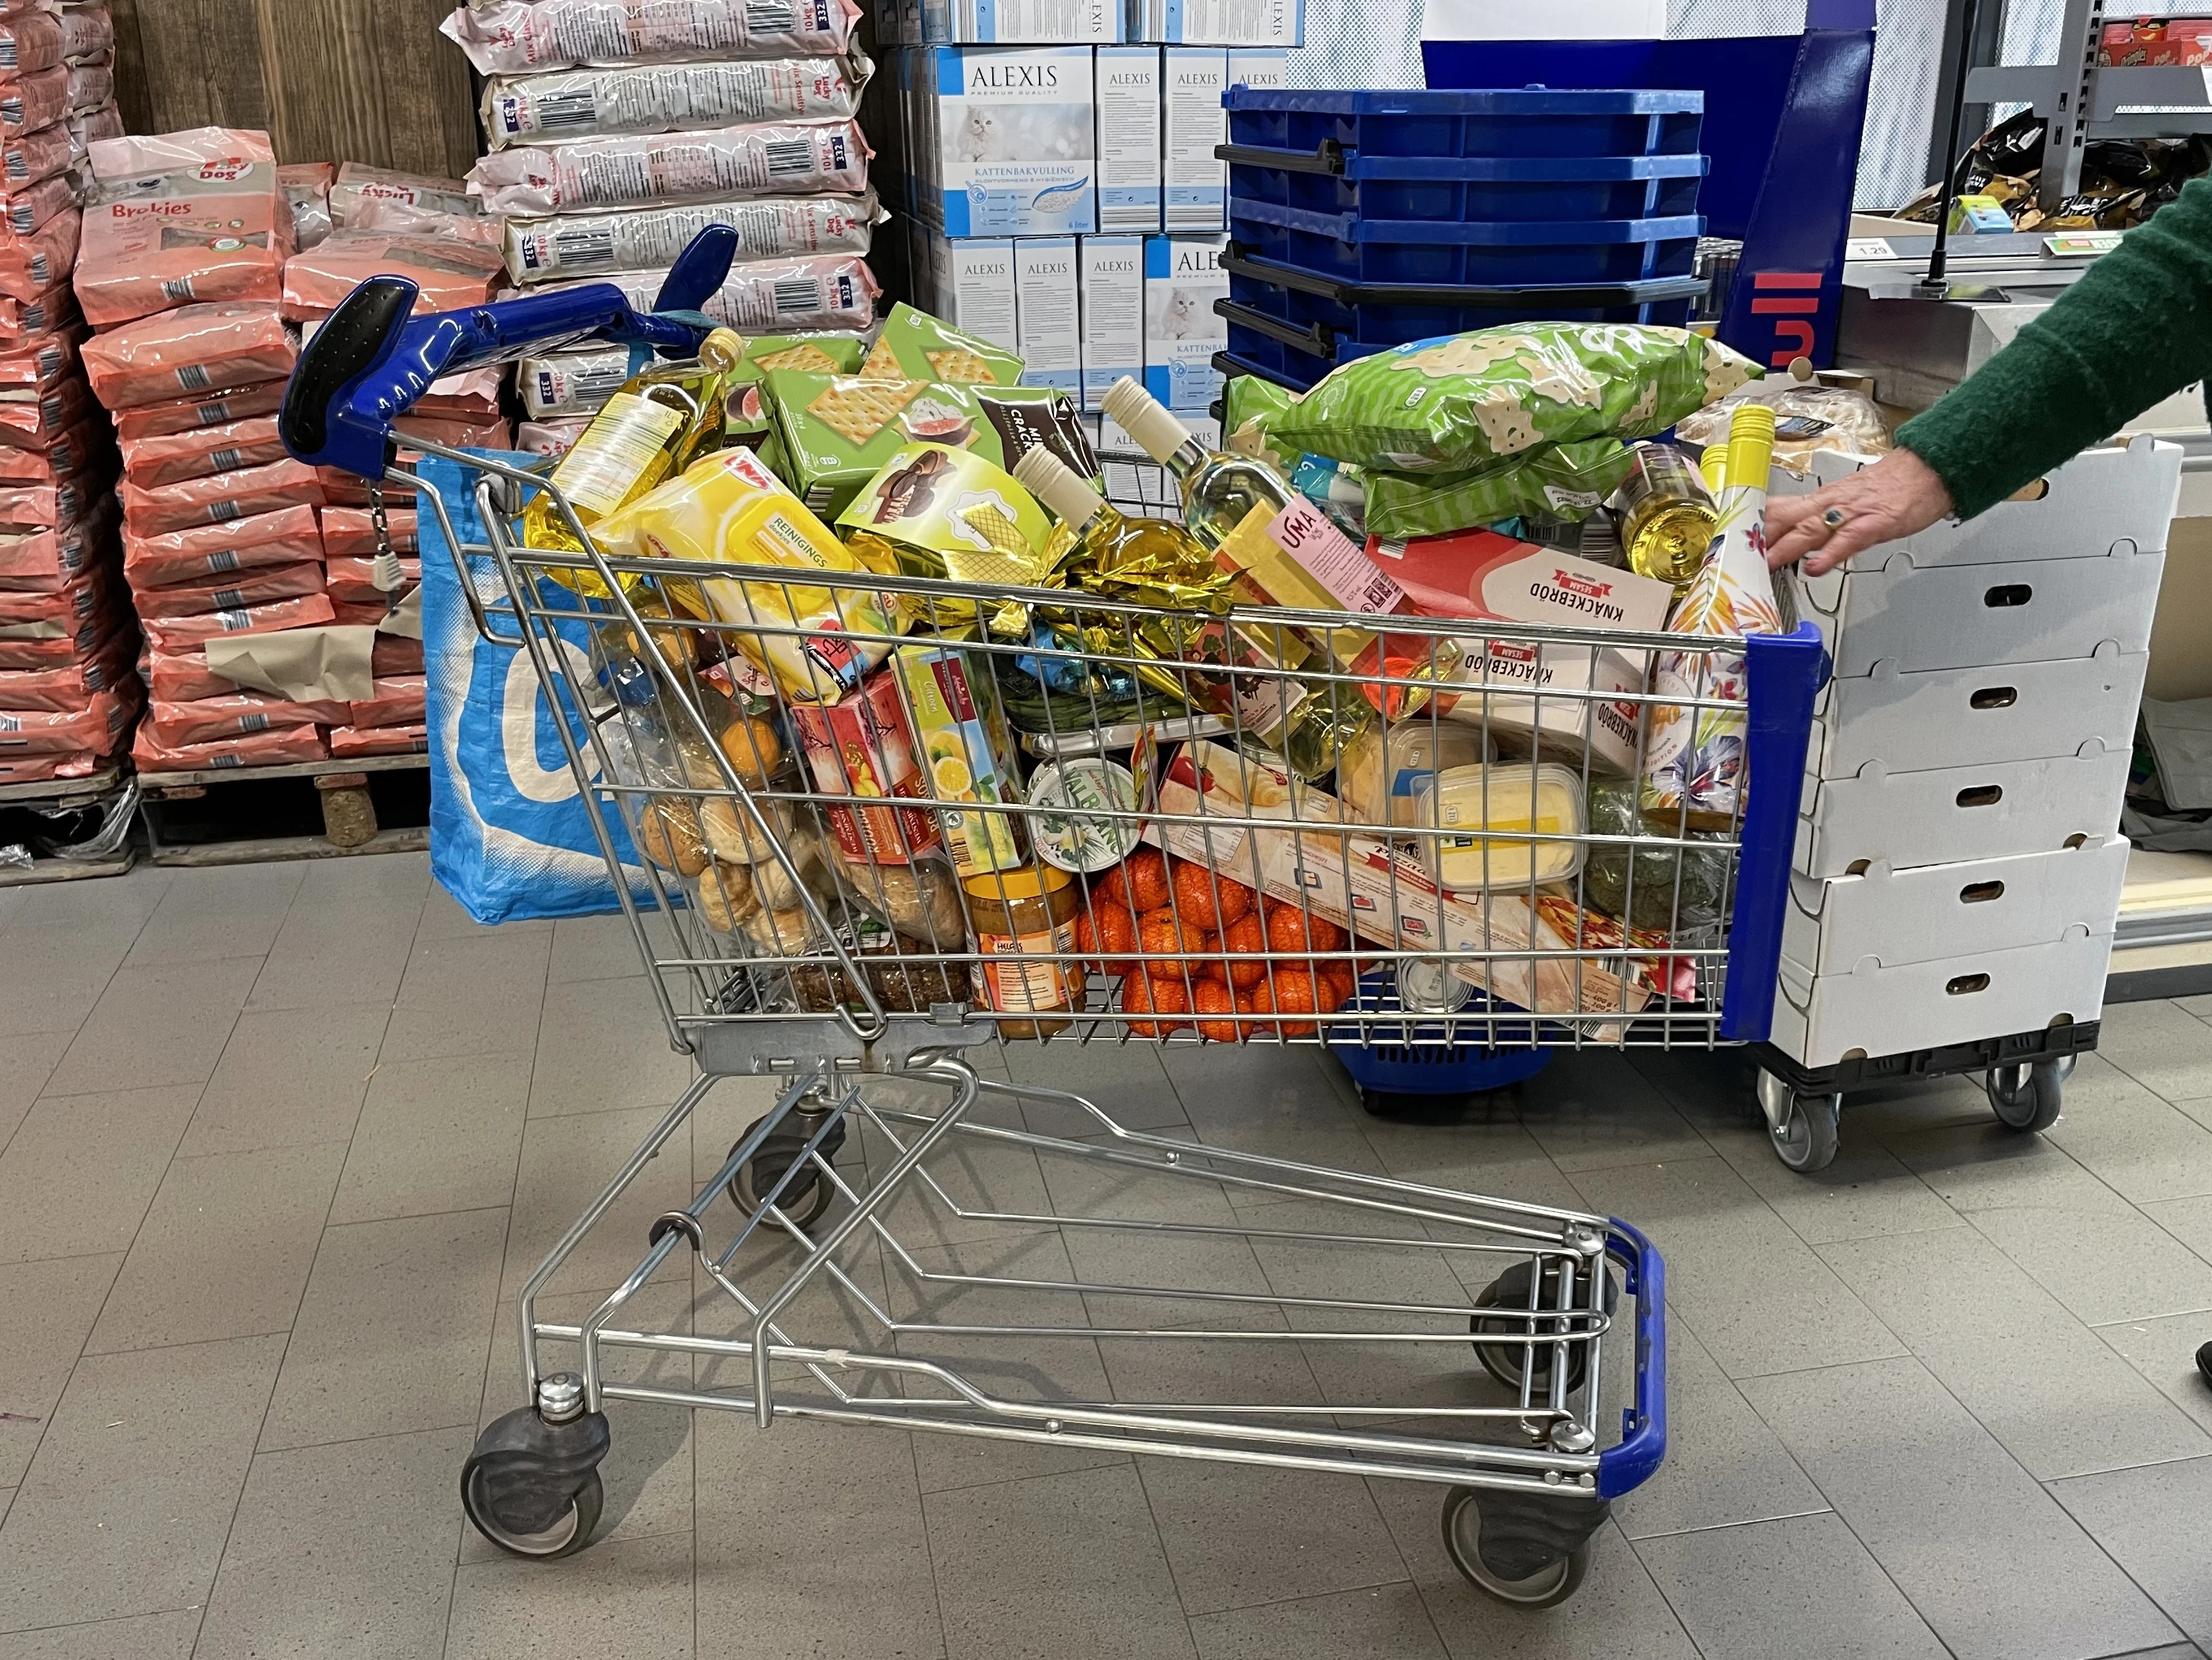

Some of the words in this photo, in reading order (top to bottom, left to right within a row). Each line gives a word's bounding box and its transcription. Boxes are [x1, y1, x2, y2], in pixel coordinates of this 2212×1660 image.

[817, 3, 829, 21] 332
[970, 65, 1059, 87] ALEXIS
[1109, 73, 1150, 84] ALEXIS
[1177, 73, 1218, 84] ALEXIS
[1239, 73, 1278, 85] ALEXIS
[795, 81, 806, 116] Sensitive
[834, 145, 845, 162] 332
[199, 170, 237, 180] Dog
[975, 166, 1075, 176] KATTENBAKVULLING
[964, 263, 1005, 275] ALEXIS
[1027, 263, 1068, 274] ALEXIS
[1094, 261, 1134, 272] ALEXIS
[1177, 251, 1219, 271] ALE
[842, 284, 851, 300] 332
[1177, 344, 1228, 353] KATTENBA
[541, 380, 552, 397] 332
[1010, 409, 1033, 453] CRACK
[769, 524, 790, 545] doekjes
[1281, 510, 1317, 549] UMA
[773, 517, 827, 568] REINIGINGS
[1569, 580, 1593, 594] SESAM
[1530, 583, 1624, 621] KNÄCKEBRÖD
[1501, 648, 1524, 659] SESAM
